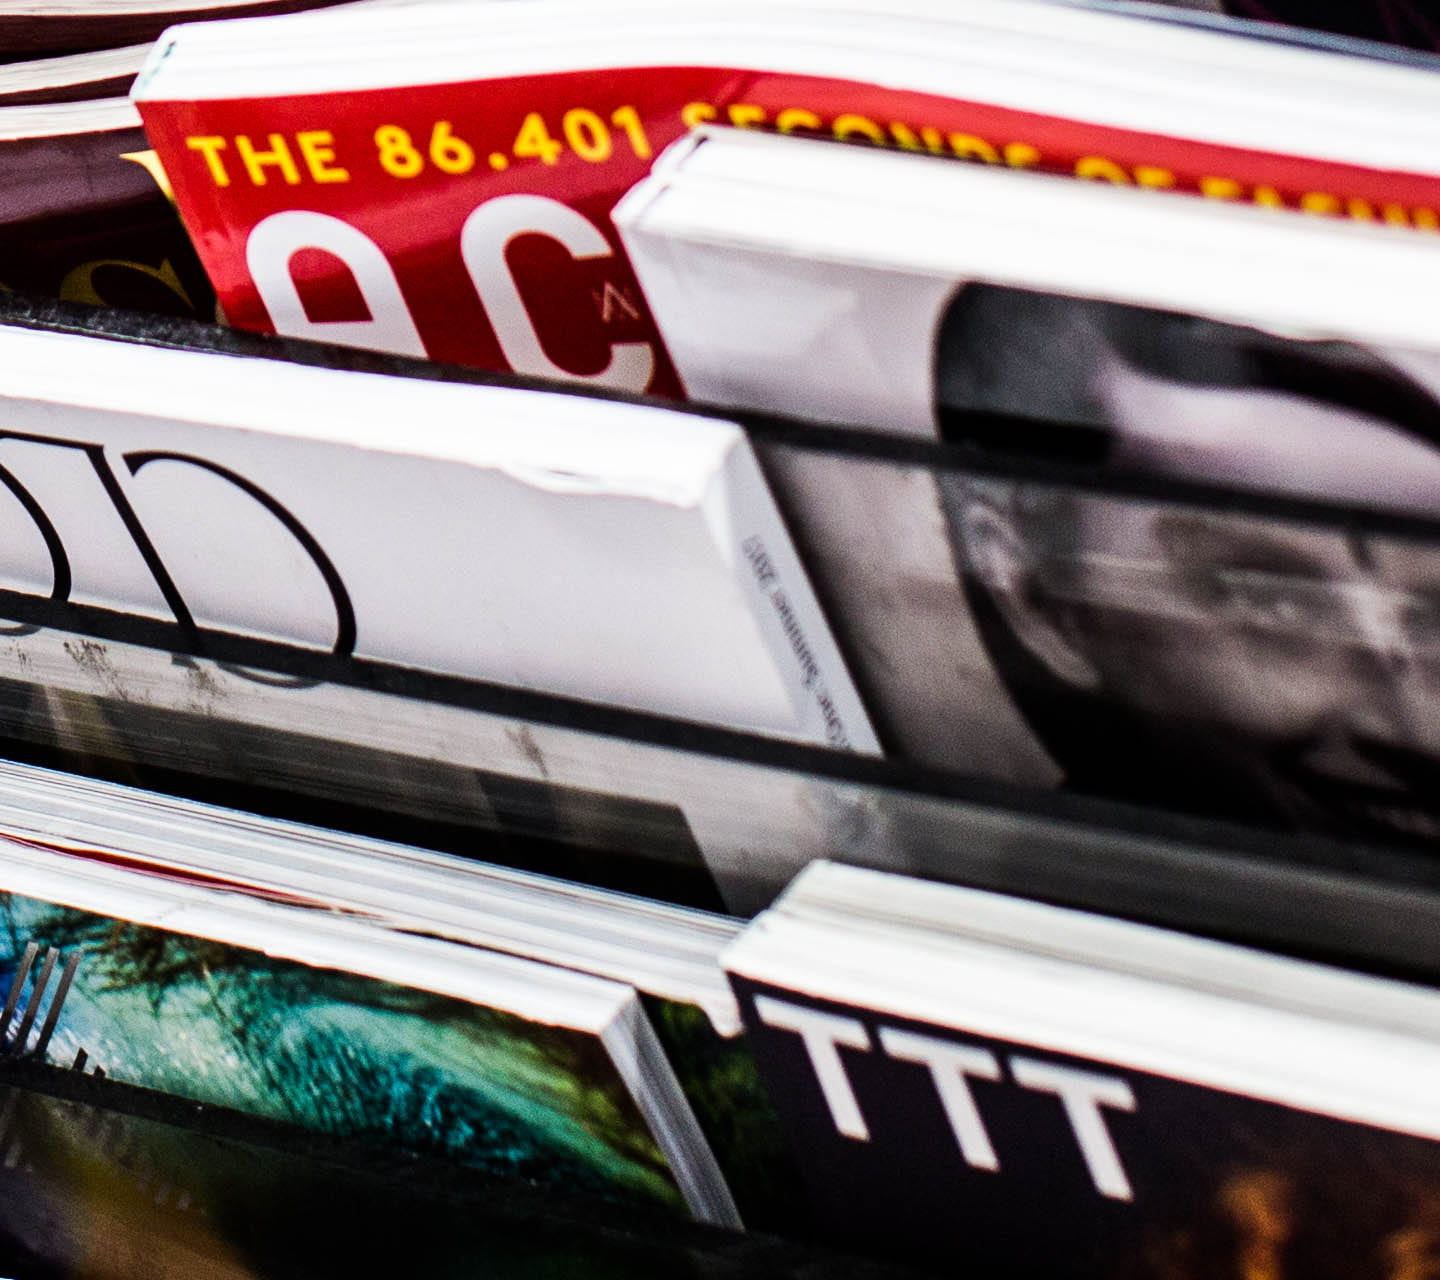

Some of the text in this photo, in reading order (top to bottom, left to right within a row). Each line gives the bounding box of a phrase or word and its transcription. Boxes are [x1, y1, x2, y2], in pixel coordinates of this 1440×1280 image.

[186, 129, 350, 188] THE
[374, 103, 651, 182] 86.401
[753, 994, 1137, 1202] TTT
